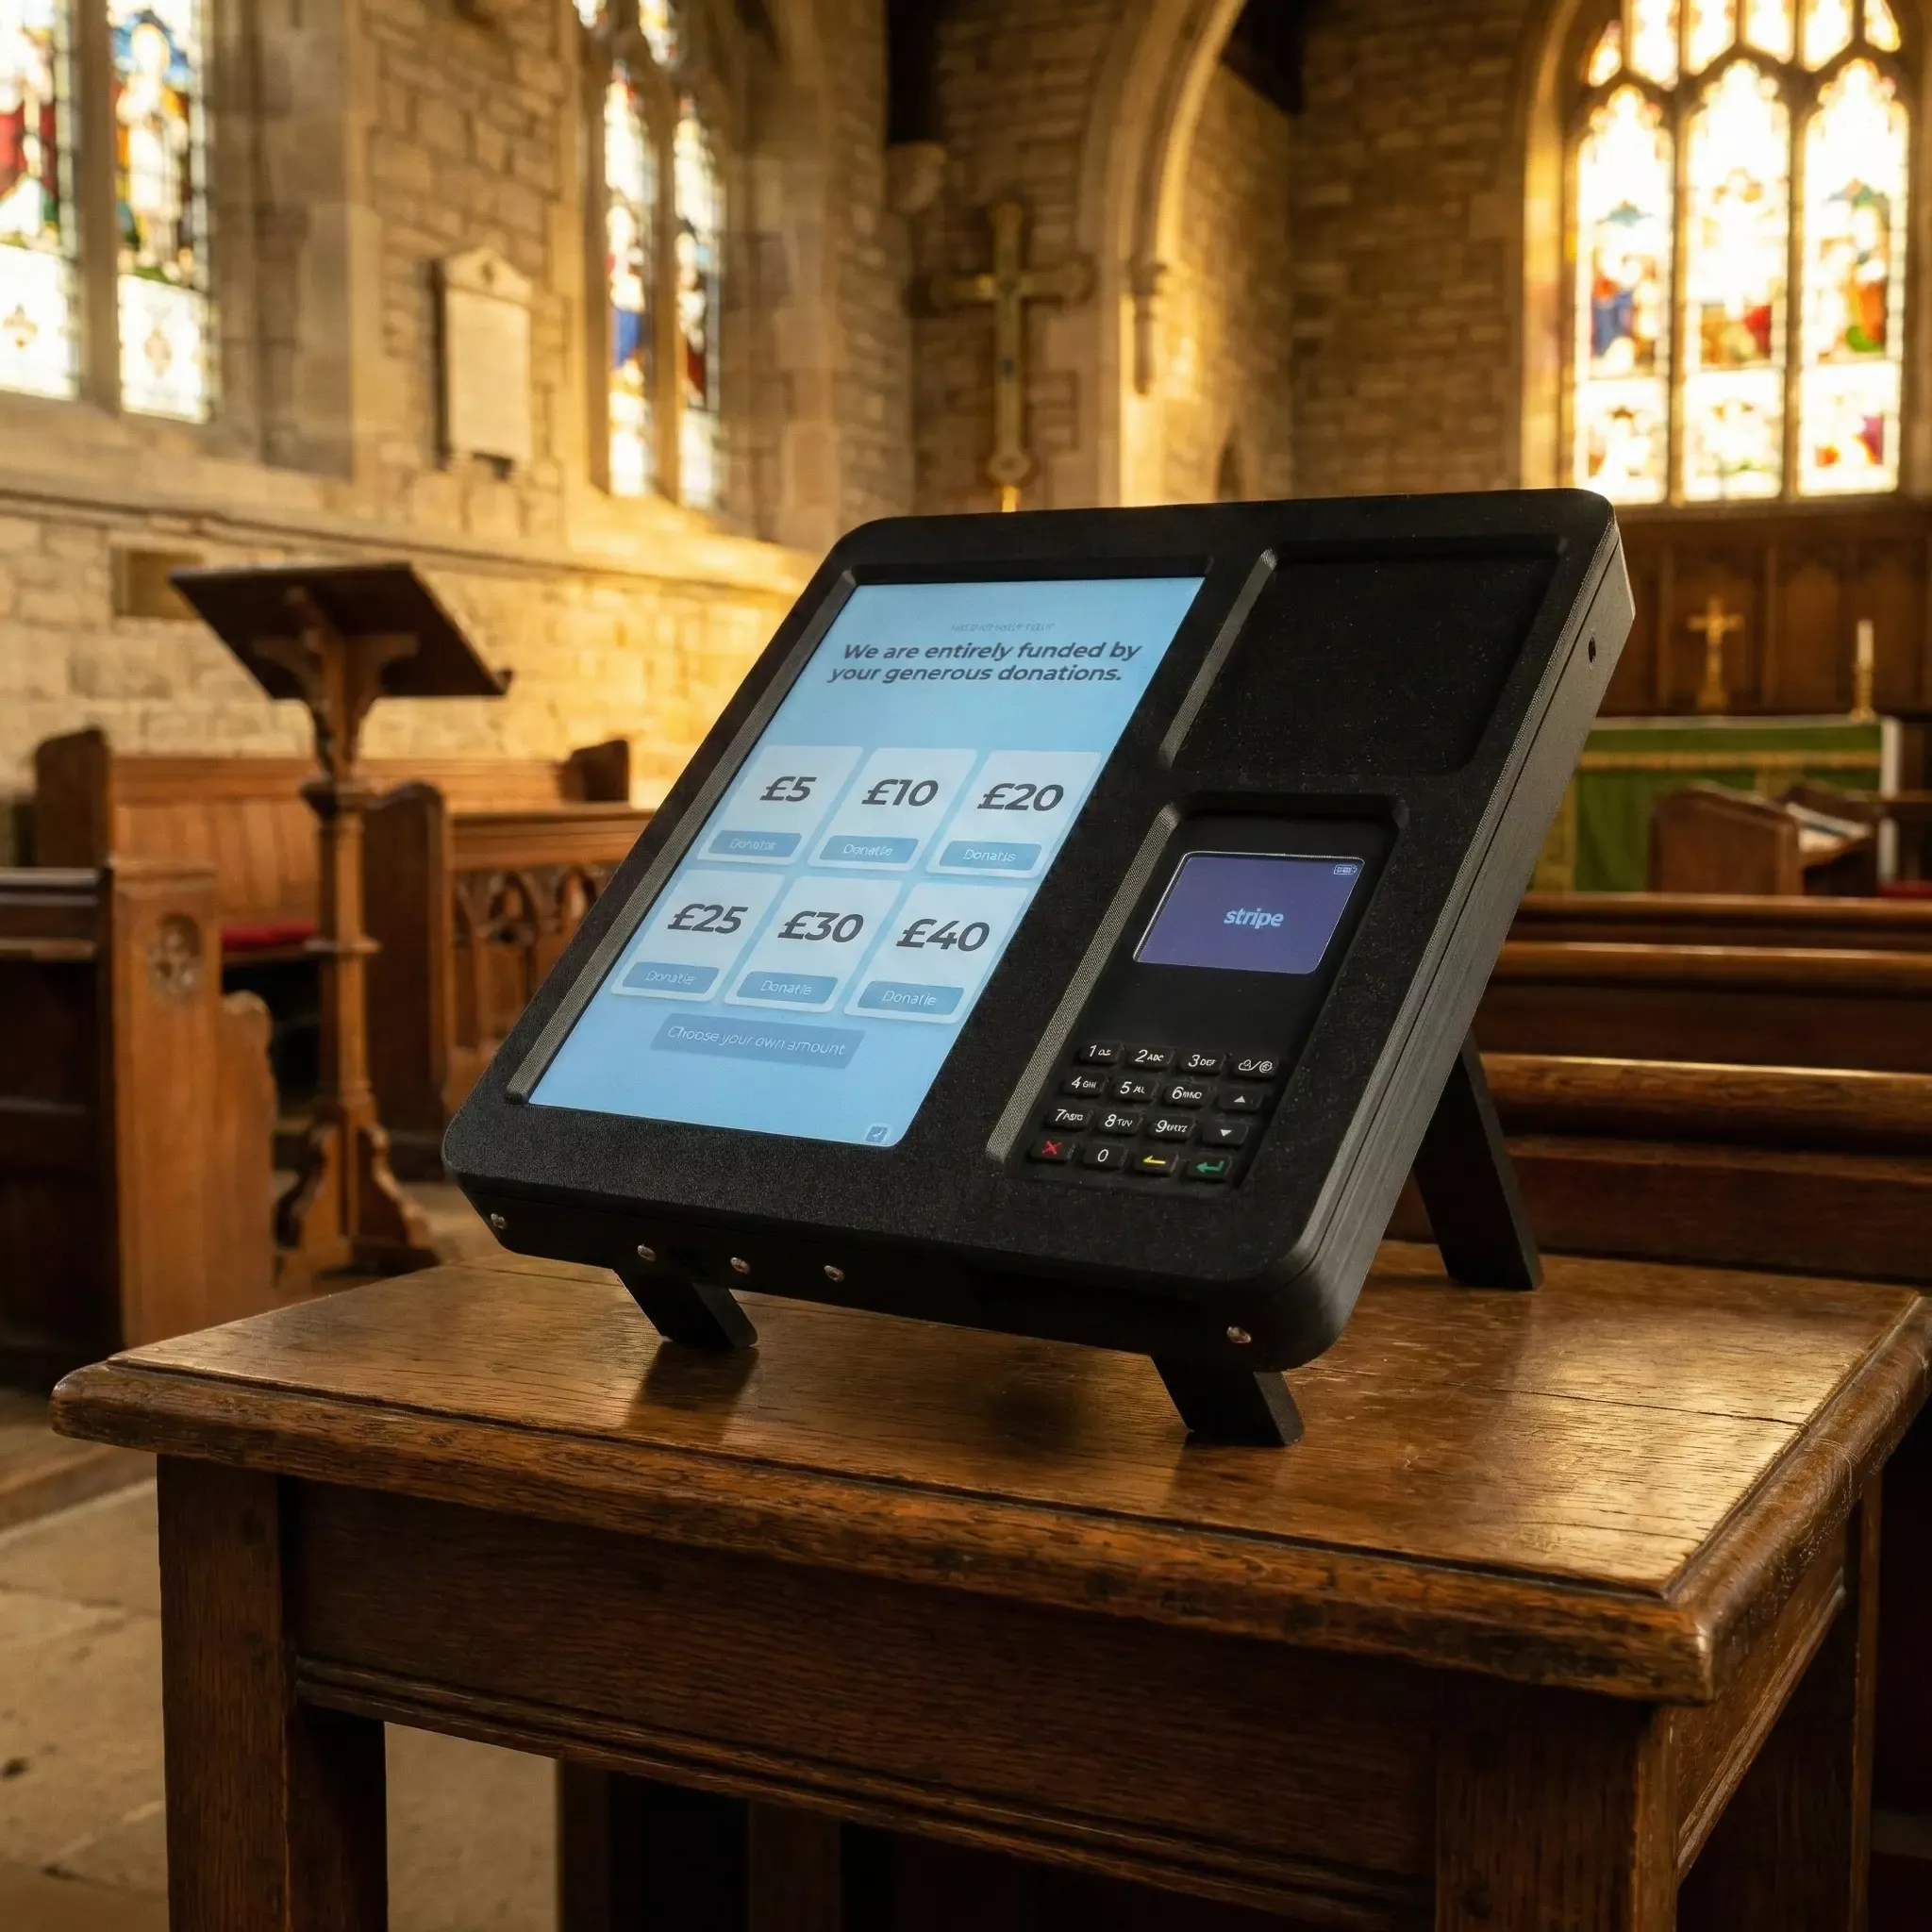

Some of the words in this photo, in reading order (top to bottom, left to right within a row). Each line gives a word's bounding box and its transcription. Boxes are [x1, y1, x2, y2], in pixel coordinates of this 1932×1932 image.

[844, 643, 878, 659] We
[883, 647, 919, 659] are
[924, 642, 1014, 661] entirely
[1017, 641, 1106, 659] funded
[1109, 641, 1143, 661] by
[827, 666, 880, 684] your
[883, 666, 992, 684] generous
[998, 664, 1123, 682] donations.
[759, 775, 818, 802] £5
[861, 778, 940, 807] £10
[977, 782, 1064, 811] £20
[667, 903, 749, 934] £25
[777, 910, 864, 943] £30
[1224, 908, 1284, 929] stripe
[896, 918, 991, 952] £40
[720, 1034, 754, 1046] your
[756, 1038, 786, 1050] own
[788, 1041, 846, 1056] amount
[1090, 1044, 1097, 1057] 1
[1135, 1049, 1148, 1062] 2
[1189, 1054, 1201, 1067] 3
[1071, 1075, 1082, 1089] 4
[1120, 1081, 1132, 1094] 5
[1172, 1087, 1184, 1100] 6
[1055, 1108, 1067, 1122] 7
[1105, 1114, 1117, 1127] 8
[1156, 1120, 1168, 1133] 9
[1097, 1149, 1109, 1162] 0
